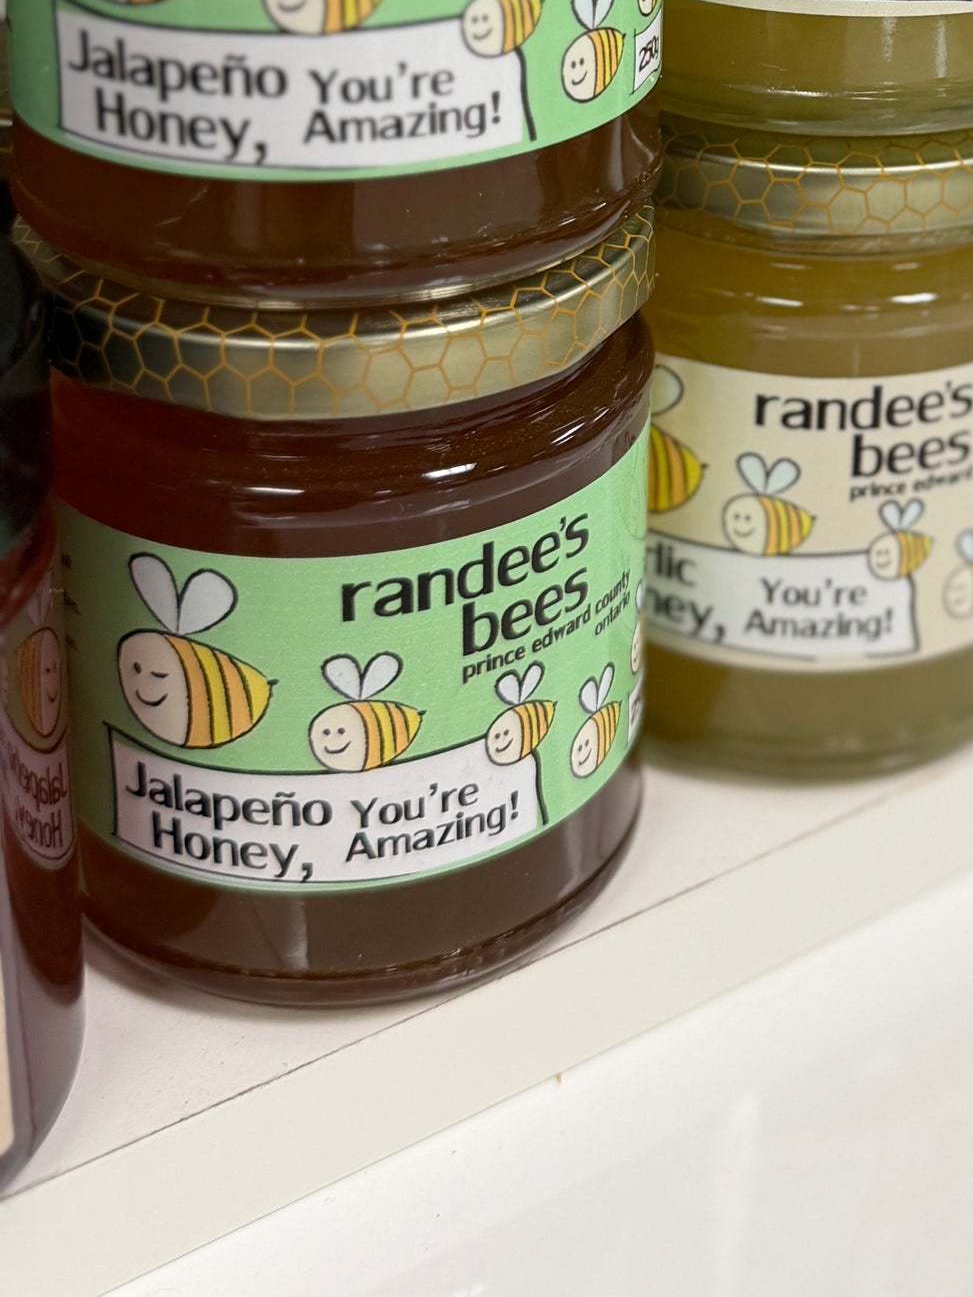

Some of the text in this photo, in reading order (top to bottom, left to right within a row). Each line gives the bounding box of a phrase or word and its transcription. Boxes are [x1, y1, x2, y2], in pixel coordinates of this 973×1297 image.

[68, 28, 288, 103] Jalapeño
[308, 60, 456, 104] You're
[94, 86, 269, 166] Honey,
[302, 90, 502, 144] Amazing!
[850, 430, 972, 479] bees
[848, 481, 907, 503] prince
[339, 511, 592, 623] randee's
[646, 540, 698, 589] lic
[759, 576, 869, 607] You're
[462, 566, 589, 657] bees
[462, 567, 632, 686] prince edward county
[594, 590, 632, 637] ontario
[646, 585, 726, 646] ney,
[743, 607, 894, 642] Amazing!
[125, 760, 333, 831] Jalapeño
[349, 781, 480, 830] You're
[151, 809, 315, 884] Honey,
[345, 788, 520, 864] Amazing!
